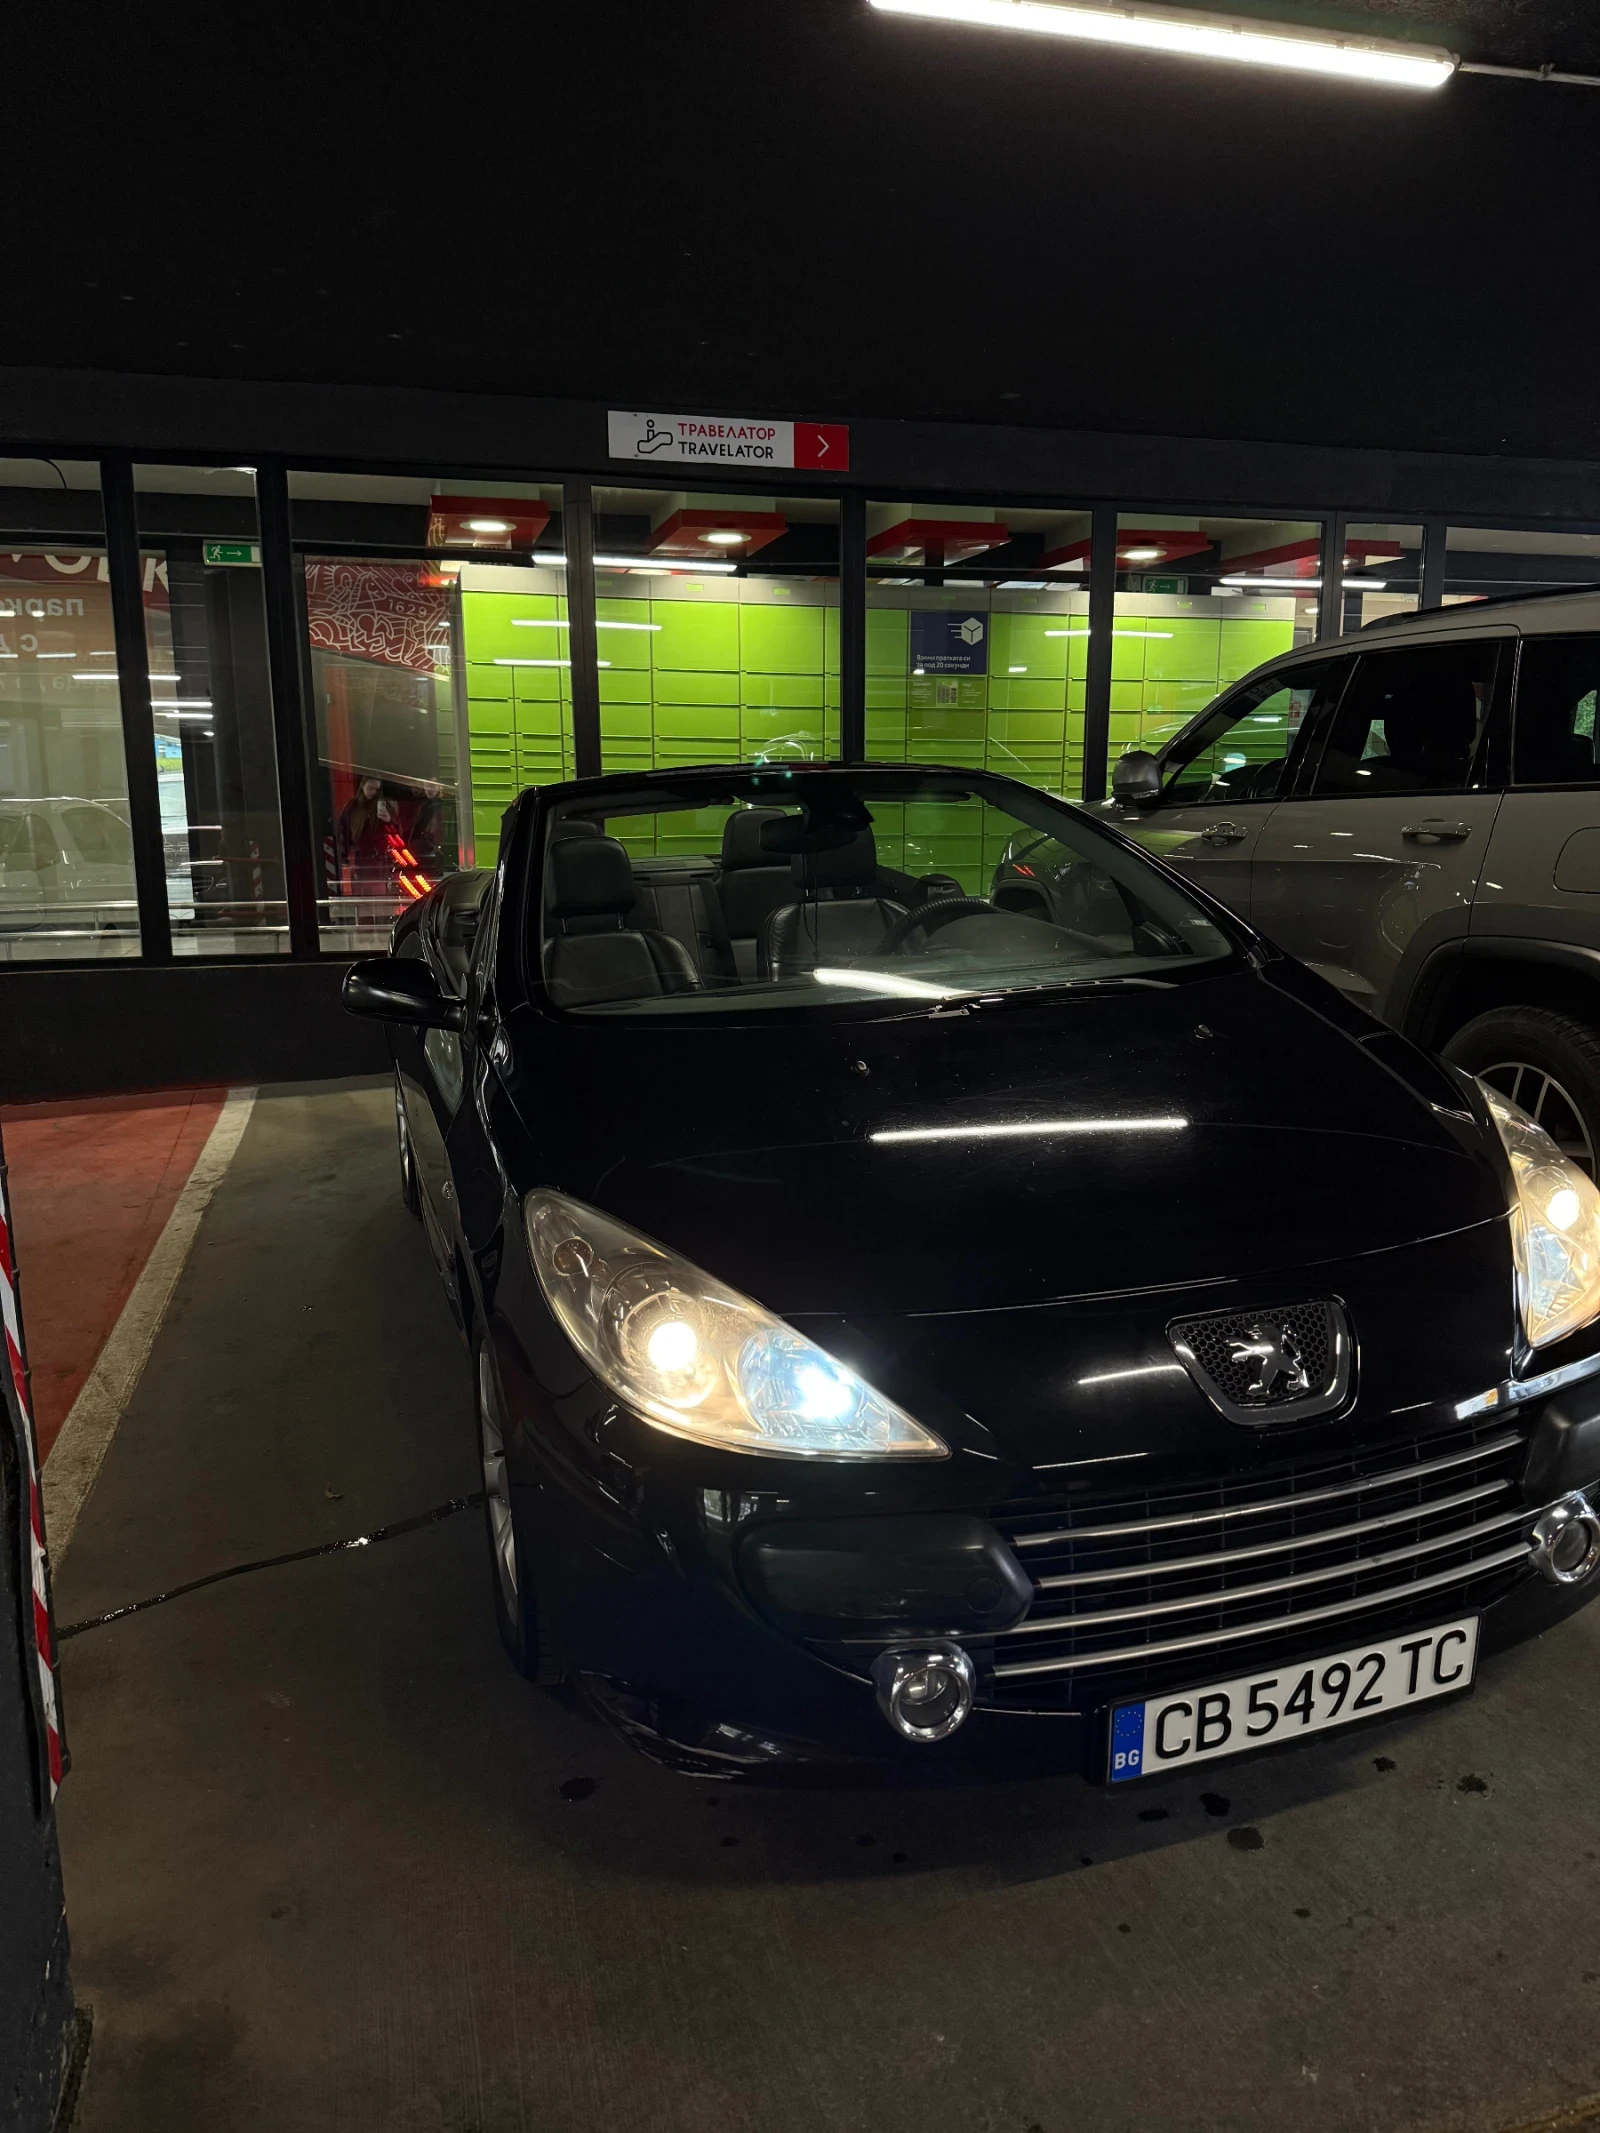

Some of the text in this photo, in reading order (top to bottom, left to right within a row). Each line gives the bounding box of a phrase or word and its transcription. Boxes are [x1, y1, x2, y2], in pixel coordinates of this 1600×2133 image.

[678, 423, 776, 440] ТРАВЕЛАТОР
[678, 441, 774, 459] TRAVELATOR
[389, 599, 427, 618] 1629
[1155, 1628, 1467, 1759] CB 5492 TC
[1114, 1749, 1140, 1770] BG
